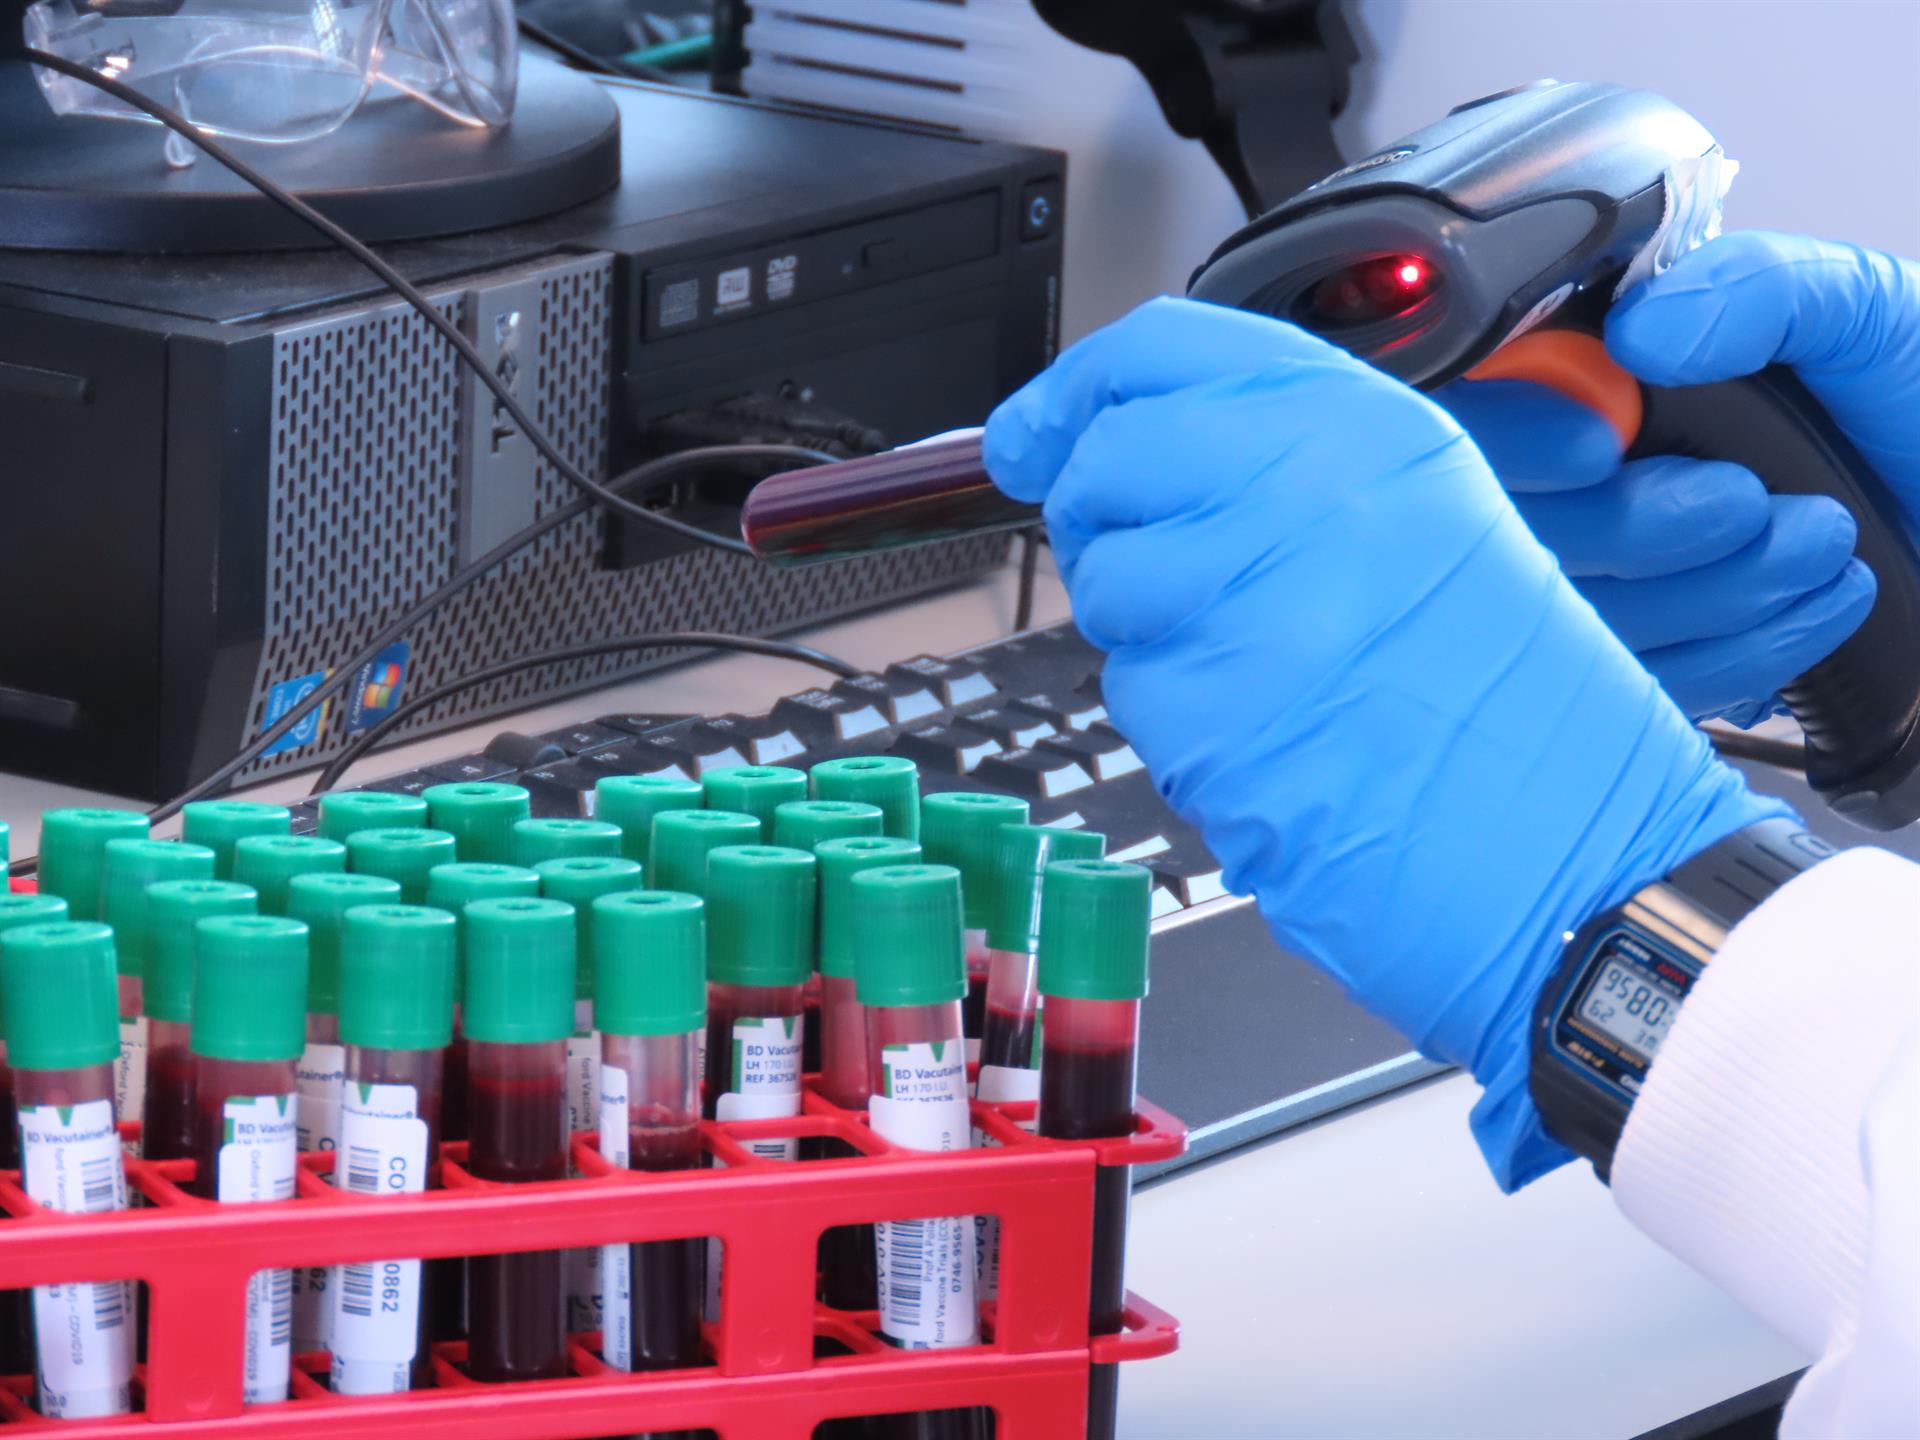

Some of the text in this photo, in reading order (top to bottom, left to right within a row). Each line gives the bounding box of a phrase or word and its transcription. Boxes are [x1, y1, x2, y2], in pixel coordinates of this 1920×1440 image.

[747, 1045, 763, 1056] BD
[746, 1060, 759, 1069] LH
[745, 1074, 764, 1083] REF
[895, 1069, 911, 1079] BD
[895, 1084, 908, 1093] LH
[935, 1243, 948, 1272] Trials
[381, 1262, 401, 1314] 0862
[934, 1275, 947, 1317] Vaccine
